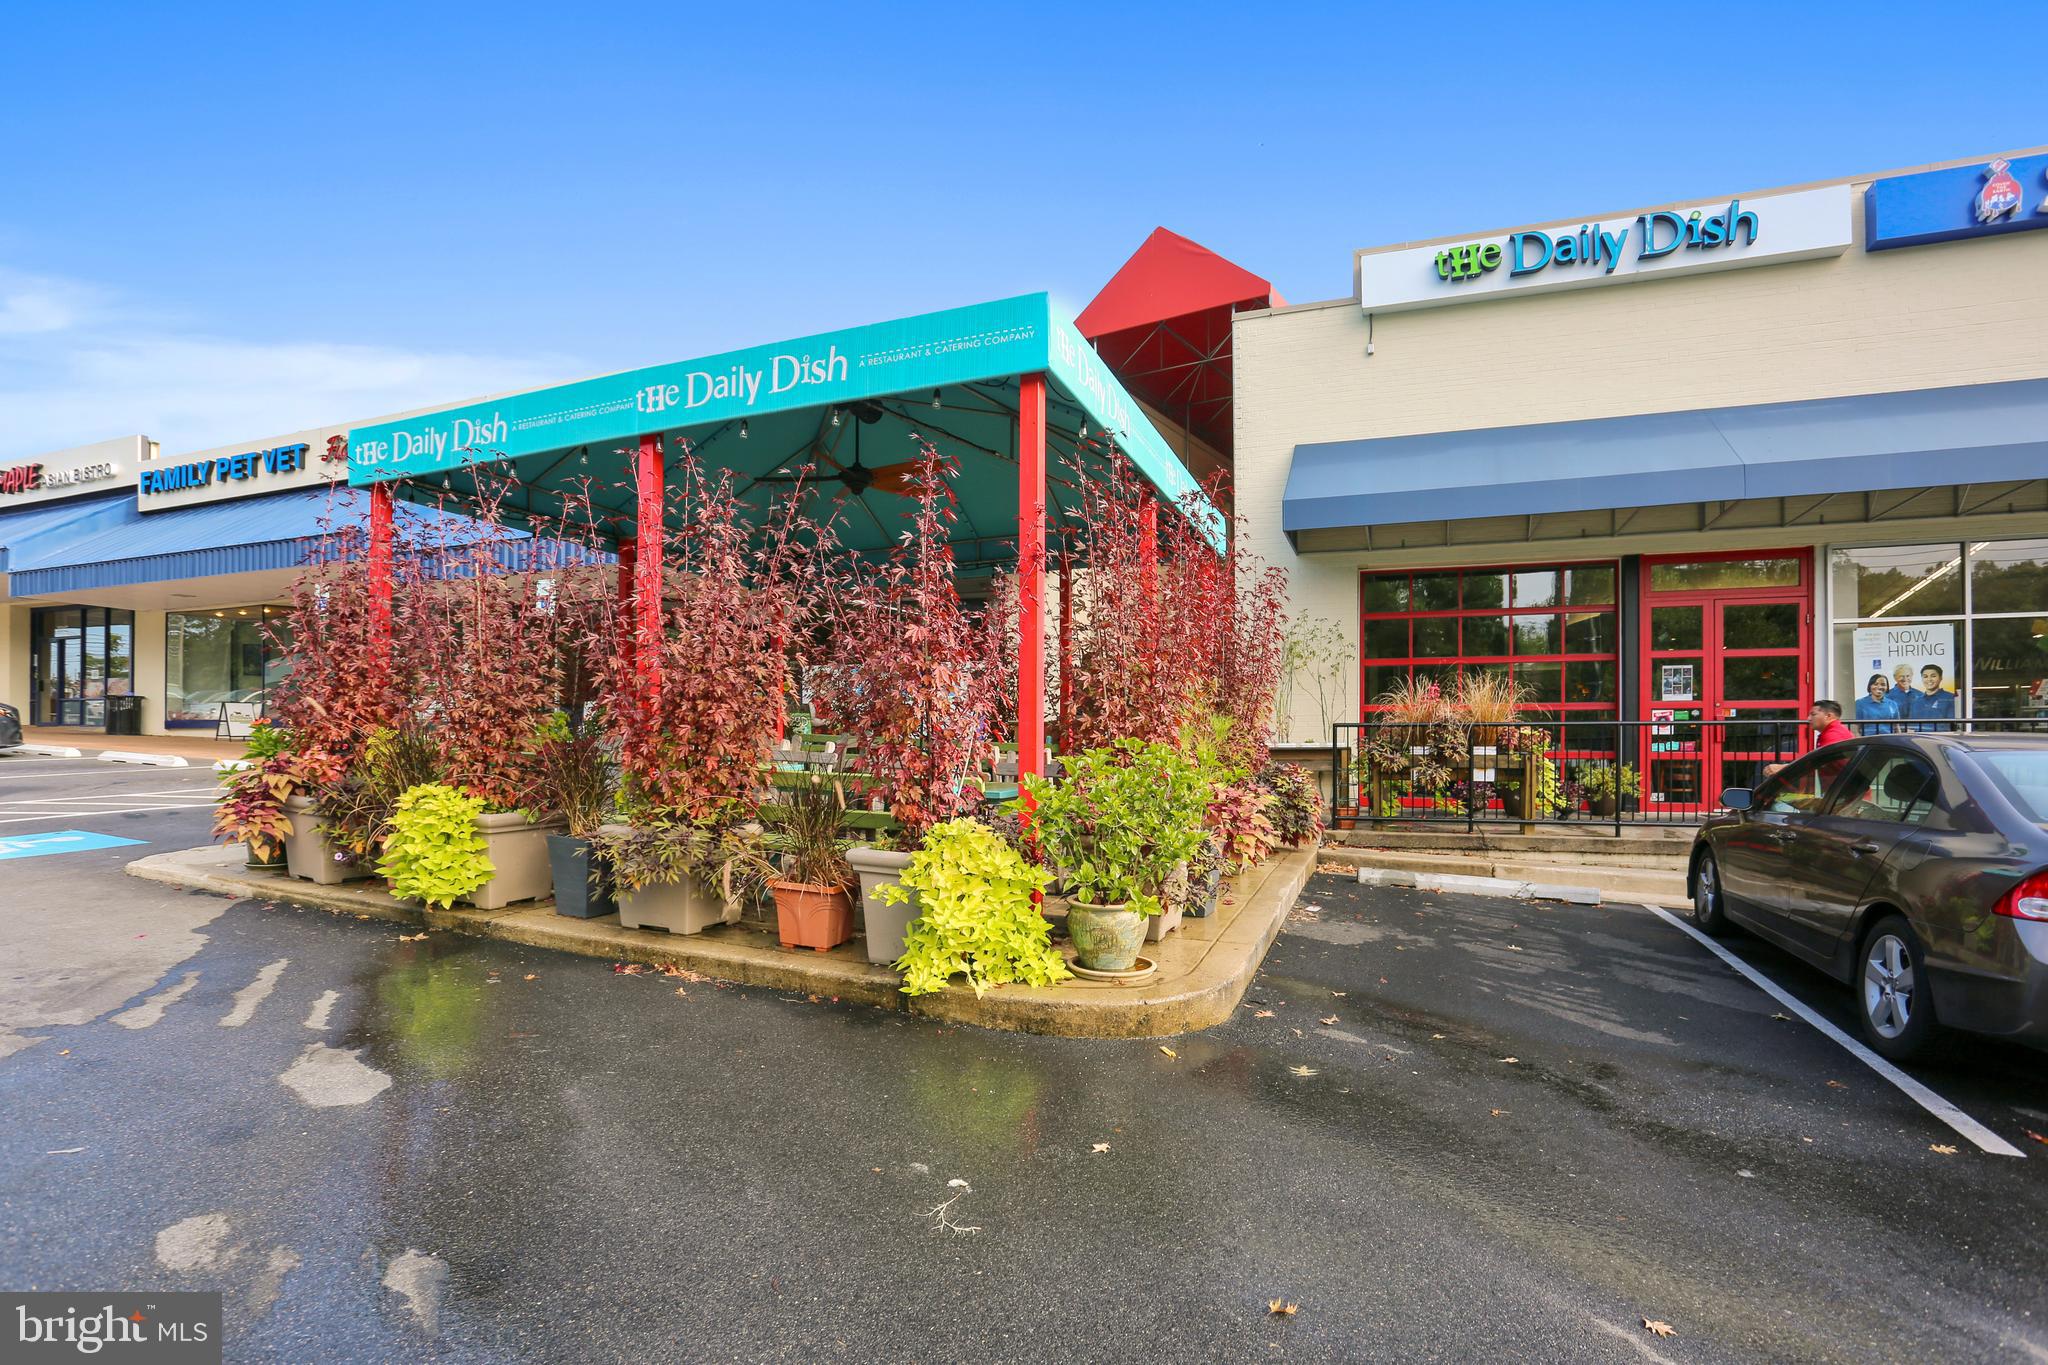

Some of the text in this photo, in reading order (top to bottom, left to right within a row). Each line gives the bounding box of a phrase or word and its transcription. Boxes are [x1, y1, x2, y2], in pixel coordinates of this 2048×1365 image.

[1509, 224, 1628, 277] Daily
[1635, 199, 1760, 260] Dish
[868, 350, 922, 367] RESTAURANT
[924, 348, 932, 357] &
[934, 339, 982, 354] CATERING
[984, 330, 1036, 346] COMPANY
[684, 365, 763, 409] Daily
[768, 345, 848, 394] Dish
[1077, 343, 1106, 416] Daily
[1107, 383, 1131, 438] Dish
[391, 428, 448, 462] Daily
[451, 412, 508, 452] Dish
[518, 416, 557, 431] RESTAURANT
[557, 416, 563, 424] &
[564, 409, 598, 422] CATERING
[598, 402, 634, 415] COMPANY
[73, 462, 112, 482] BISTRO
[140, 443, 310, 494] FAMILY PET VET
[1887, 630, 1929, 644] NOW
[1888, 643, 1945, 657] HIRING
